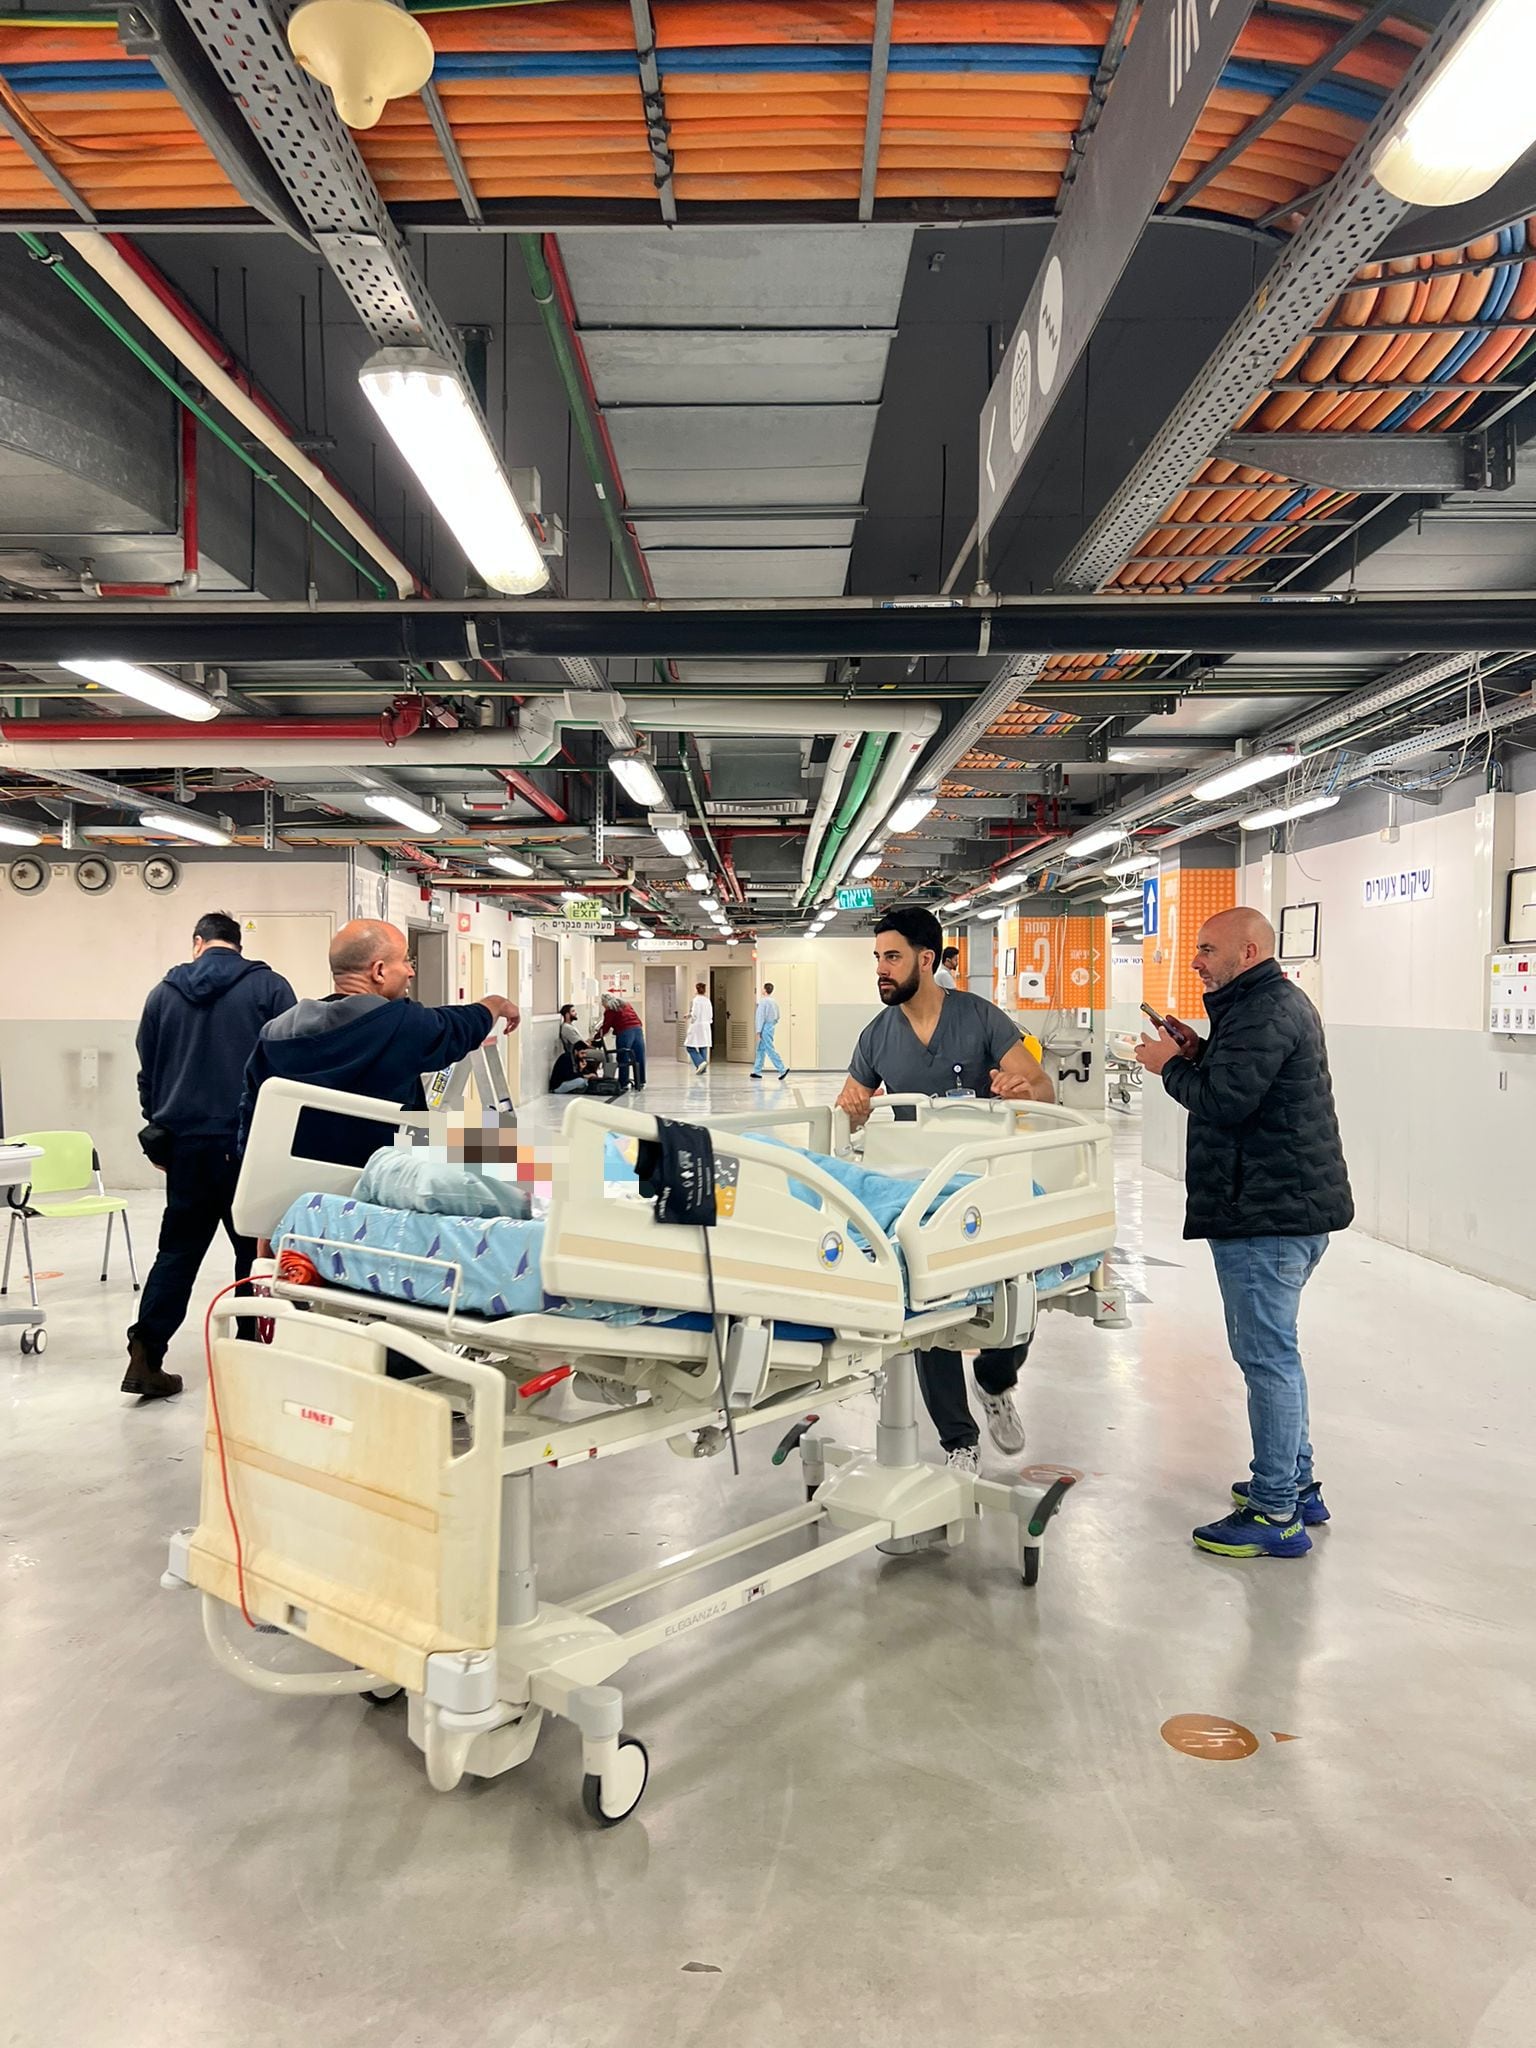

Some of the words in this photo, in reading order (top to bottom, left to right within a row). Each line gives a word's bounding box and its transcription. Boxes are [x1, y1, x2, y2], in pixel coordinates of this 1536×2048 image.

[1365, 875, 1397, 902] צעירים
[1401, 869, 1430, 901] שיקום
[573, 901, 600, 909] יציאה
[840, 888, 872, 908] יציאה
[573, 910, 599, 918] EXIT
[552, 920, 582, 930] מבקרים
[585, 921, 612, 929] מעליות
[1025, 921, 1050, 936] קומה
[301, 1408, 334, 1426] LINET
[1280, 1522, 1303, 1540] HOKA
[664, 1603, 720, 1637] ELEGANZA
